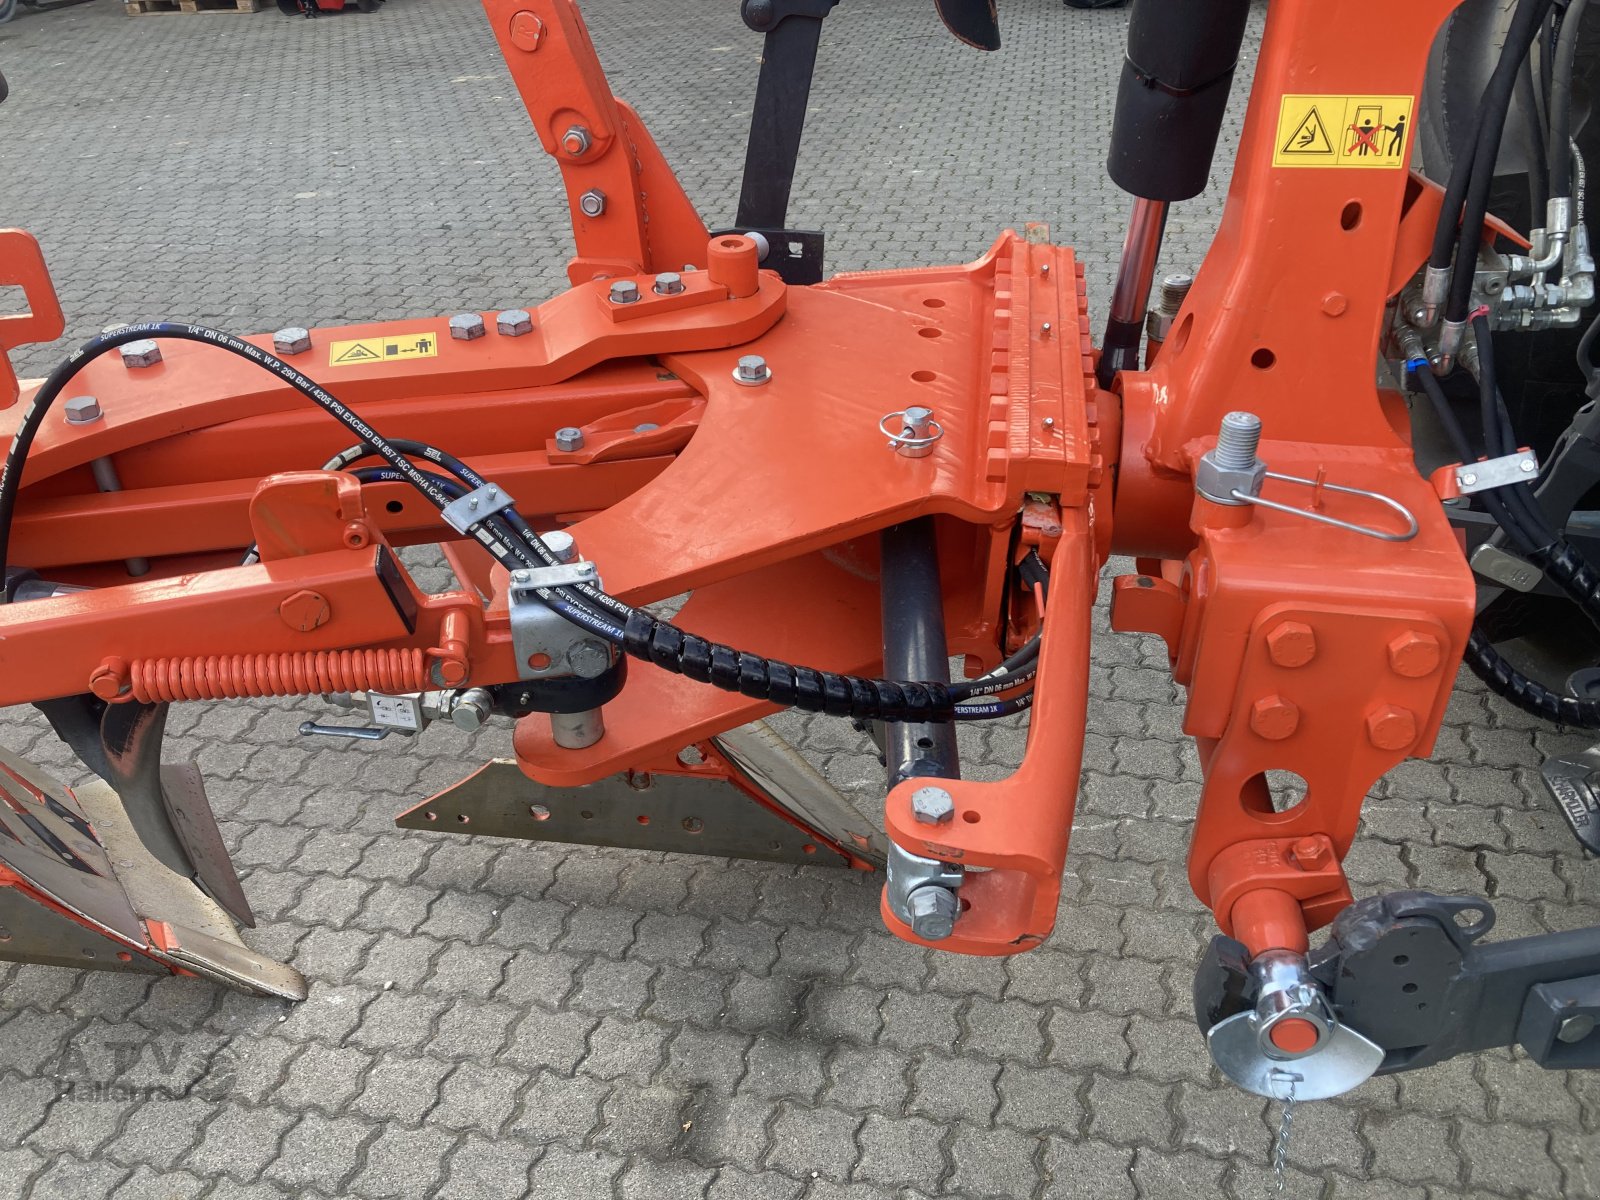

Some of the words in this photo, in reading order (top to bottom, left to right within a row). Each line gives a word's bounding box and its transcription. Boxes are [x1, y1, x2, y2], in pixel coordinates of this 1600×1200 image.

[100, 323, 150, 342] SUPERSTREAM
[204, 330, 217, 340] DN
[217, 334, 228, 344] 06
[228, 338, 244, 350] mm
[244, 344, 262, 360] Max.
[263, 355, 280, 371] W.P.
[281, 367, 296, 380] 290
[295, 375, 311, 390] Bar
[313, 389, 332, 405] 4205
[330, 401, 345, 416] PSI
[342, 411, 374, 439] EXCEED
[371, 436, 384, 448] EN
[382, 445, 397, 459] 857
[394, 457, 410, 472] 1SC
[407, 468, 430, 490] MSHA
[424, 447, 442, 462] SEL
[530, 538, 542, 550] DN
[542, 553, 554, 564] mm
[582, 585, 597, 597] Bar
[598, 593, 615, 607] 4205
[614, 602, 629, 616] PSI
[564, 605, 615, 634] SUPERSTREAM
[984, 685, 994, 694] DN
[994, 683, 1002, 692] 06
[954, 705, 990, 714] PERSTREAM
